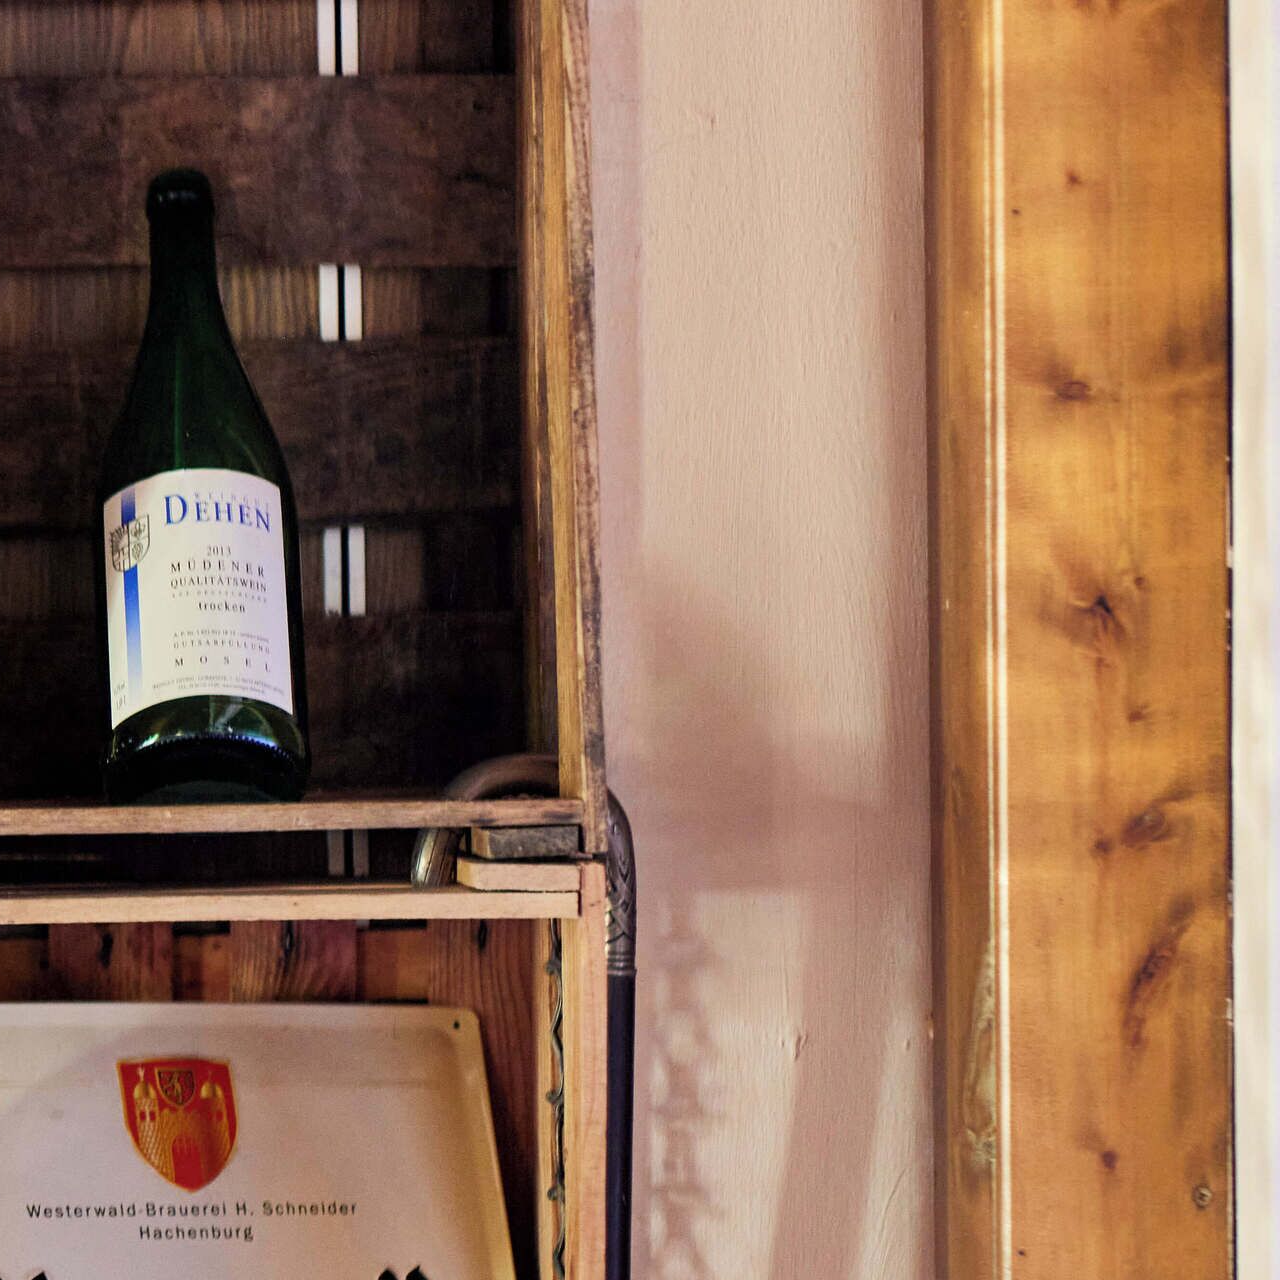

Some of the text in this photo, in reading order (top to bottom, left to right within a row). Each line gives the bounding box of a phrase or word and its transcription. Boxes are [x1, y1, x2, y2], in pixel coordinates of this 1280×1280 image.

[163, 493, 271, 533] DEHEN
[170, 557, 265, 578] MÜDENER
[170, 574, 268, 593] QUALITÄTSWEIN
[197, 601, 246, 613] trocken
[174, 655, 271, 673] MOSEL
[26, 1201, 357, 1219] Westerwald-Brauerei H. Schneider
[138, 1225, 255, 1242] Hachenburg
